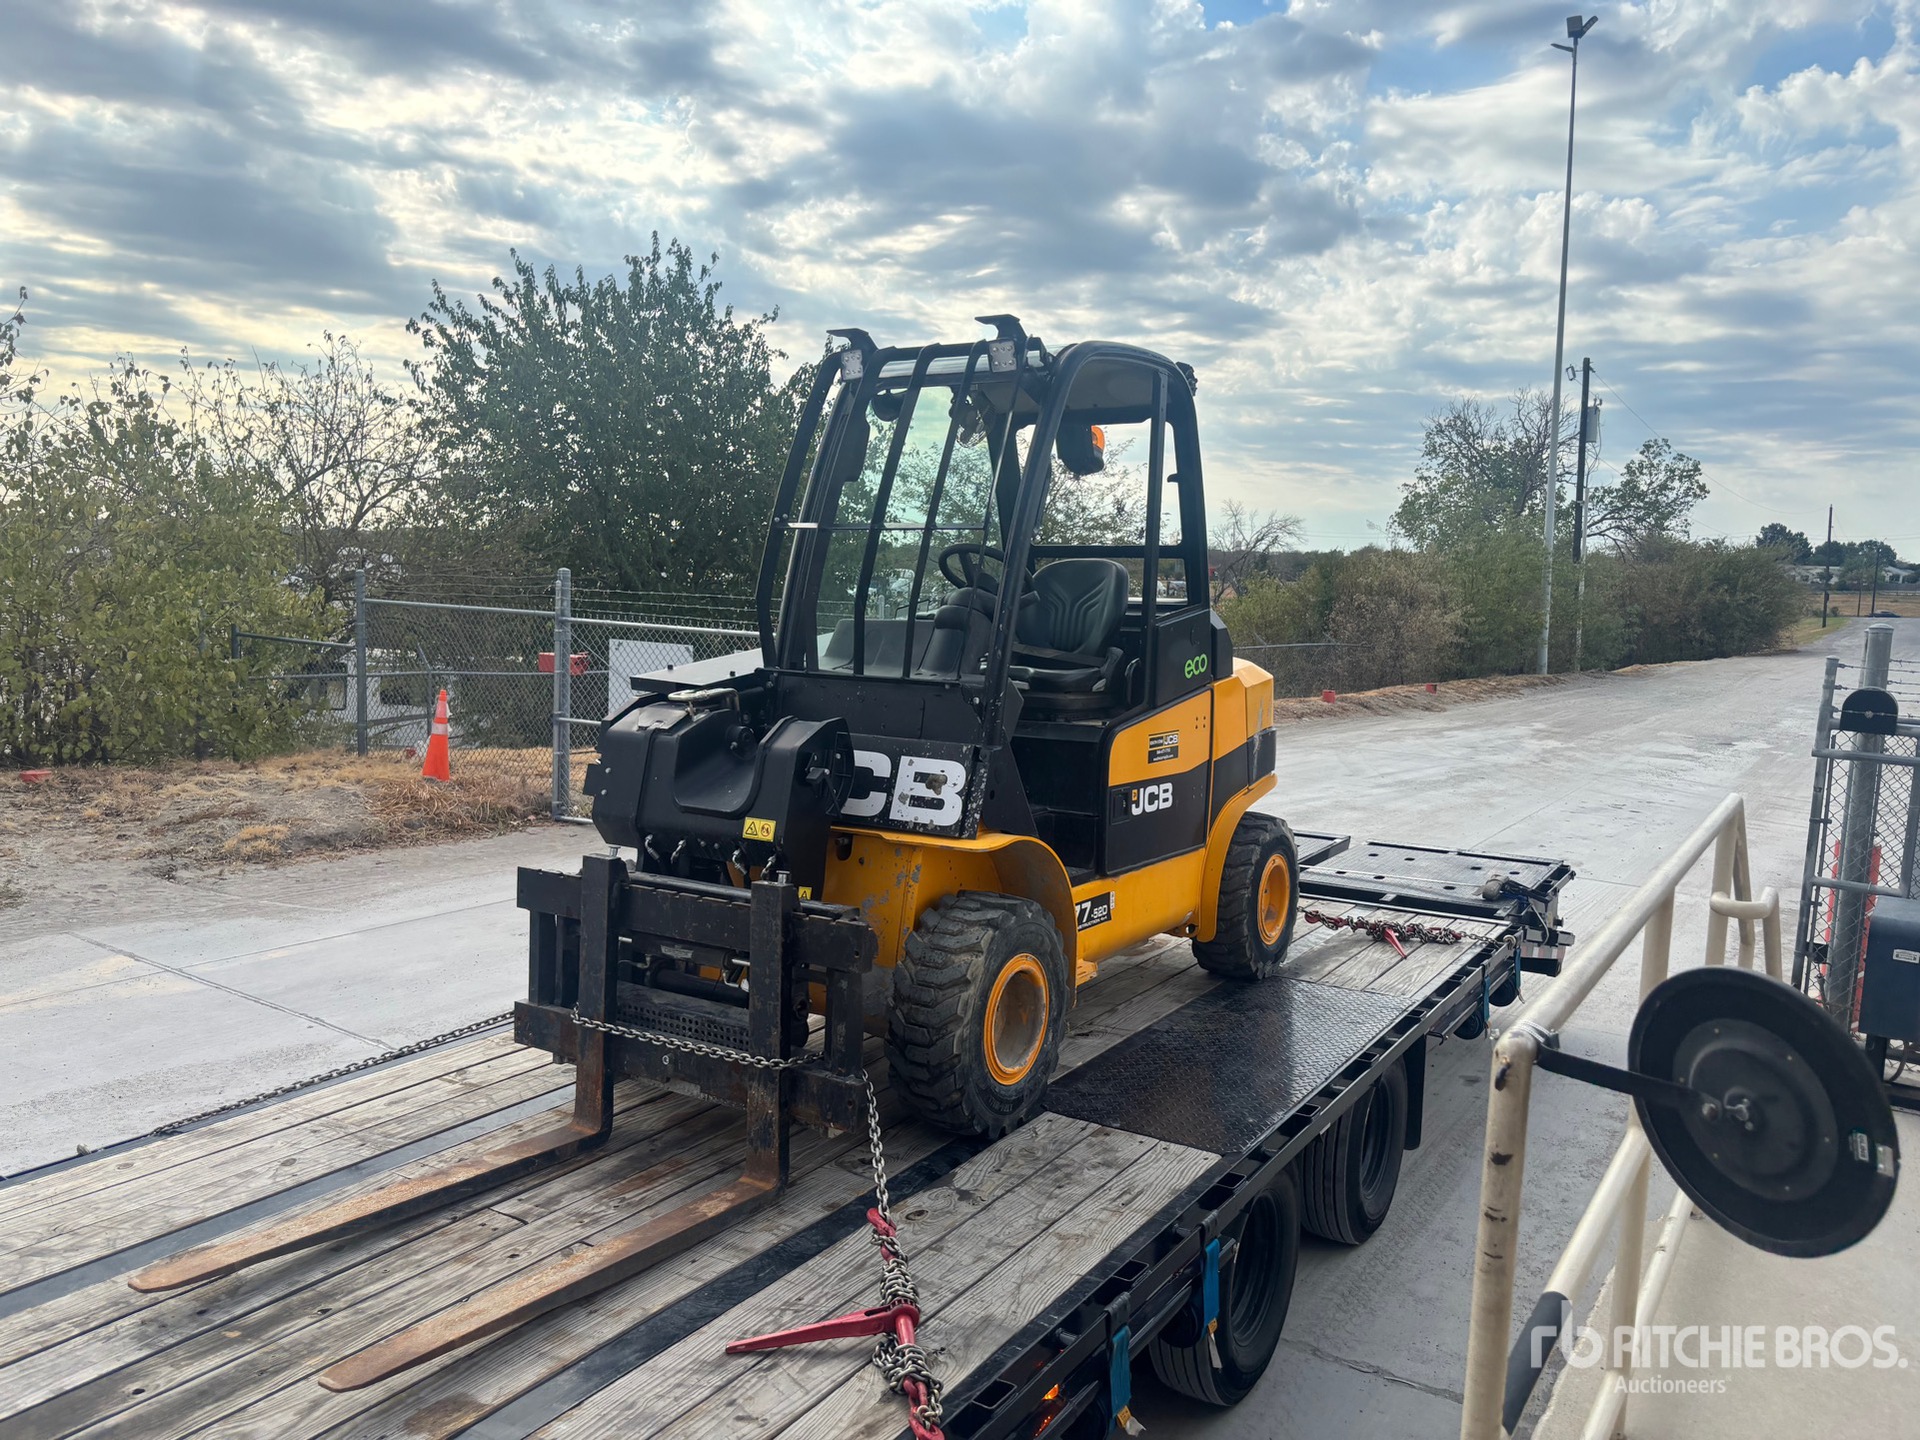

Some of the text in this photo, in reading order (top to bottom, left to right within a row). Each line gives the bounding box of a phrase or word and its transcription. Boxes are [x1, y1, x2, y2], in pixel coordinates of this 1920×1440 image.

[1185, 654, 1208, 679] eco
[841, 750, 966, 826] CB
[1131, 783, 1173, 816] JCB
